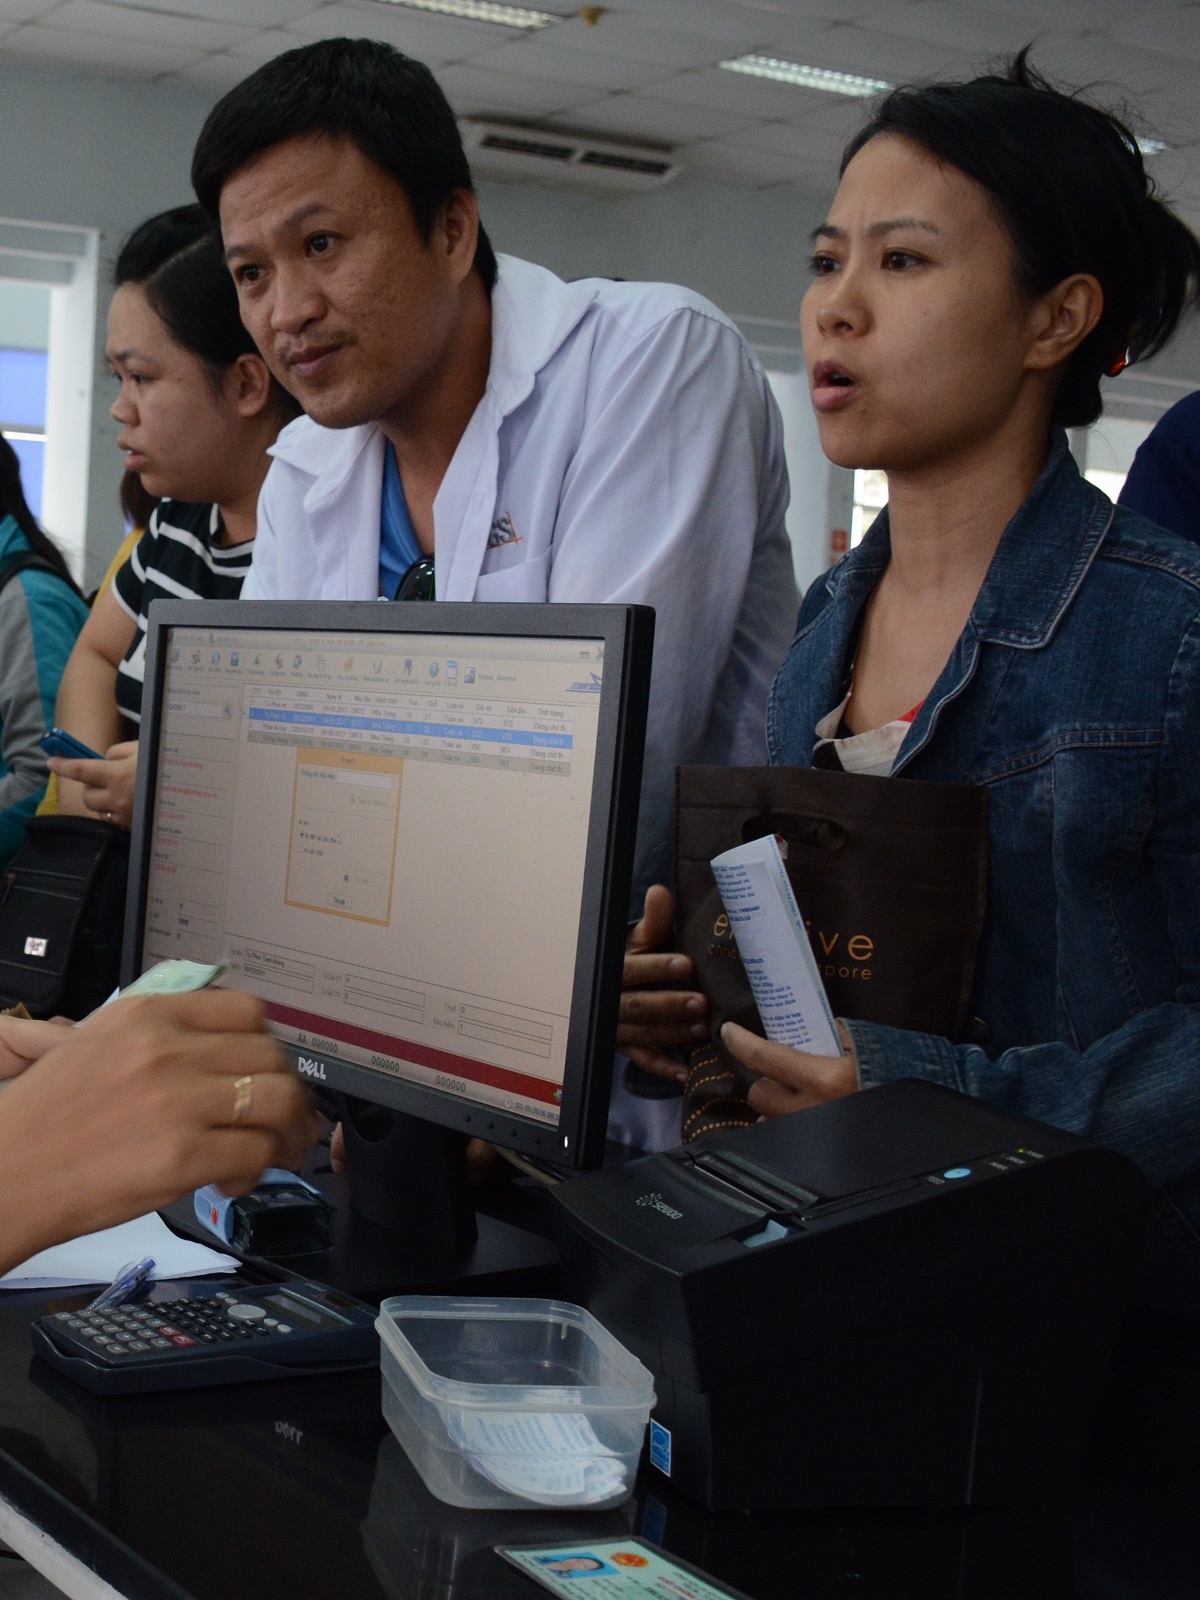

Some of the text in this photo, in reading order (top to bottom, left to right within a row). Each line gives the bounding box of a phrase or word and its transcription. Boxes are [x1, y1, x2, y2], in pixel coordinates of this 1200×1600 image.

[298, 1056, 326, 1080] DELL
[371, 1055, 400, 1073] 000000
[435, 1075, 466, 1093] 000000
